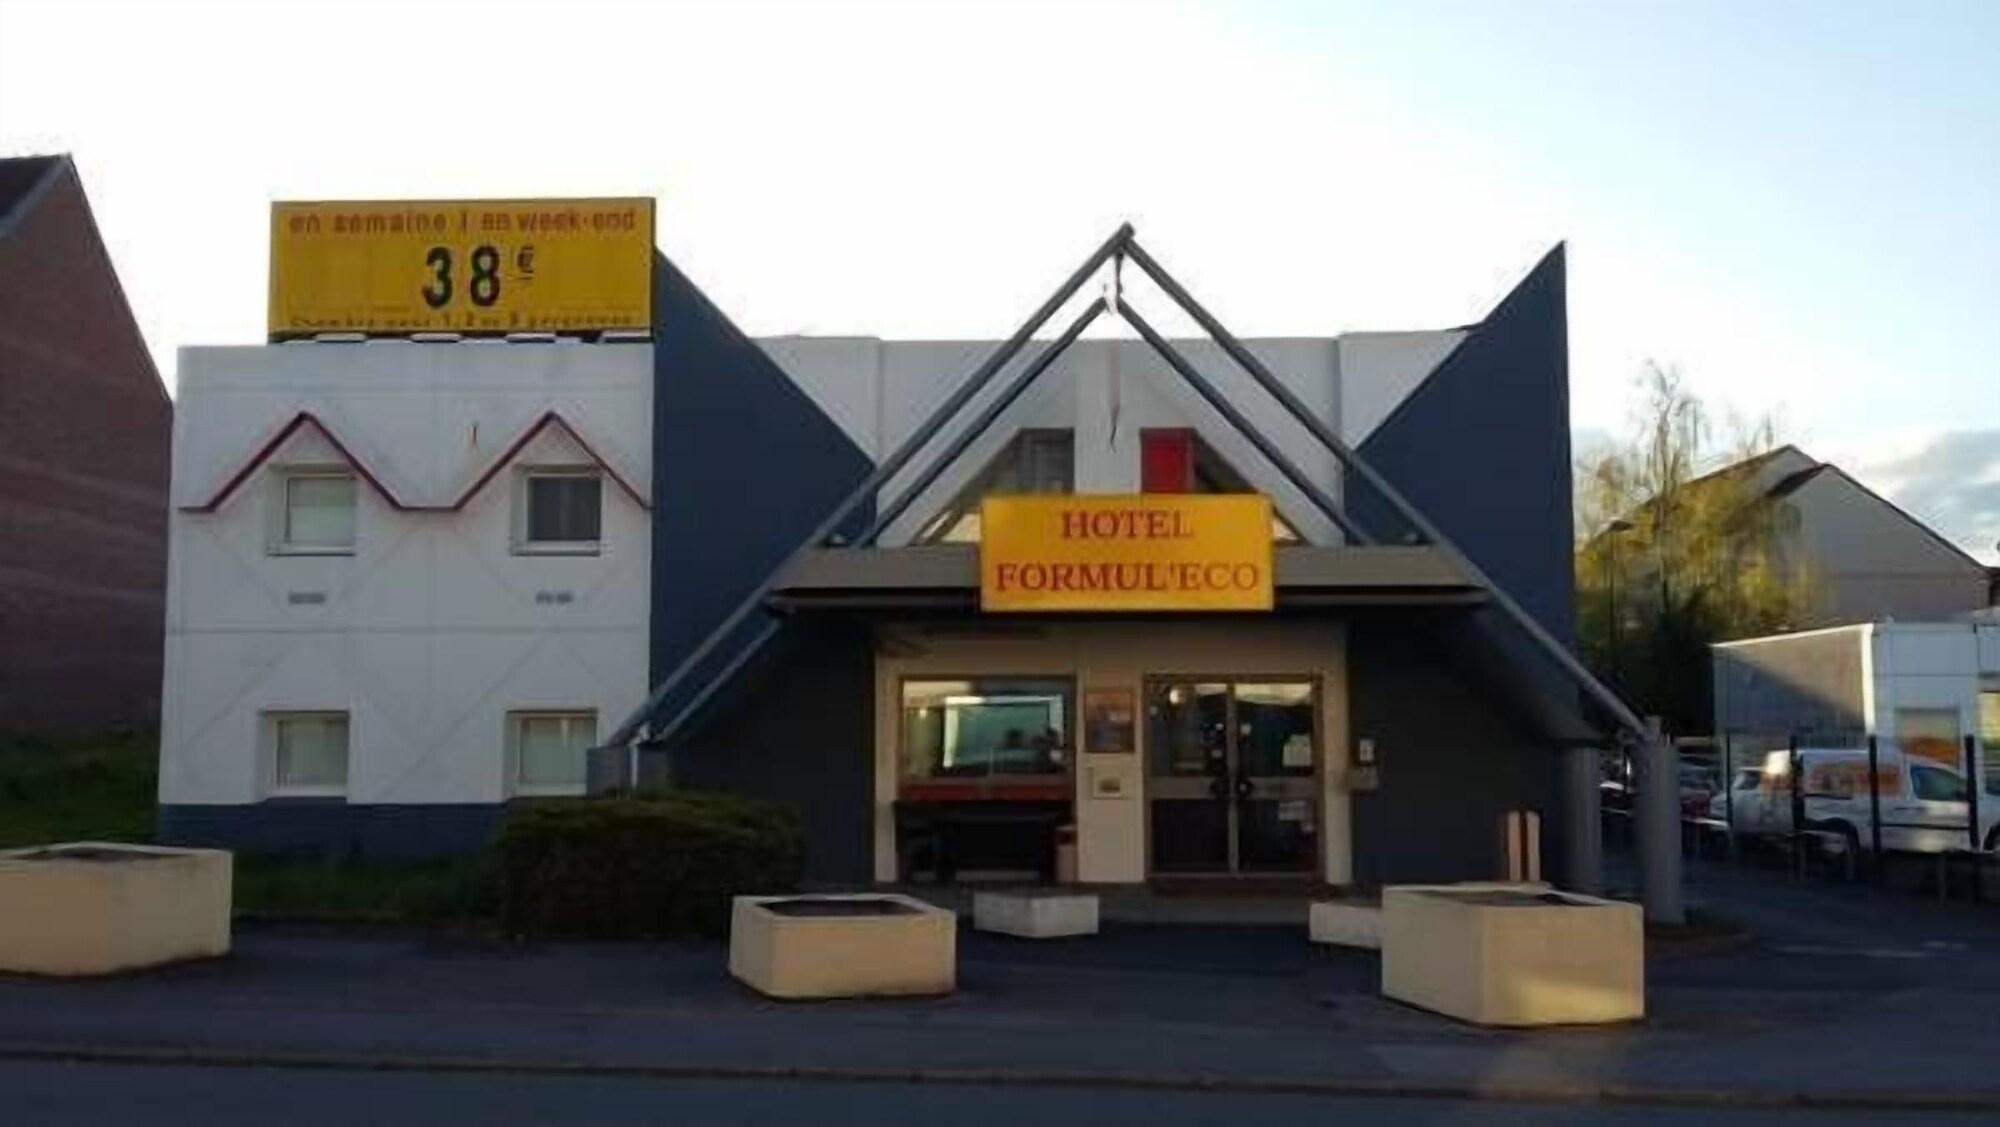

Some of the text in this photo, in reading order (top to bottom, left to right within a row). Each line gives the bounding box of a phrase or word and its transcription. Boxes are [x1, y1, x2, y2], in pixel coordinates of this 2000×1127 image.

[290, 214, 321, 233] en
[335, 213, 445, 234] semaine
[1062, 511, 1193, 539] HOTEL
[996, 563, 1258, 591] FORMUL'ECO
